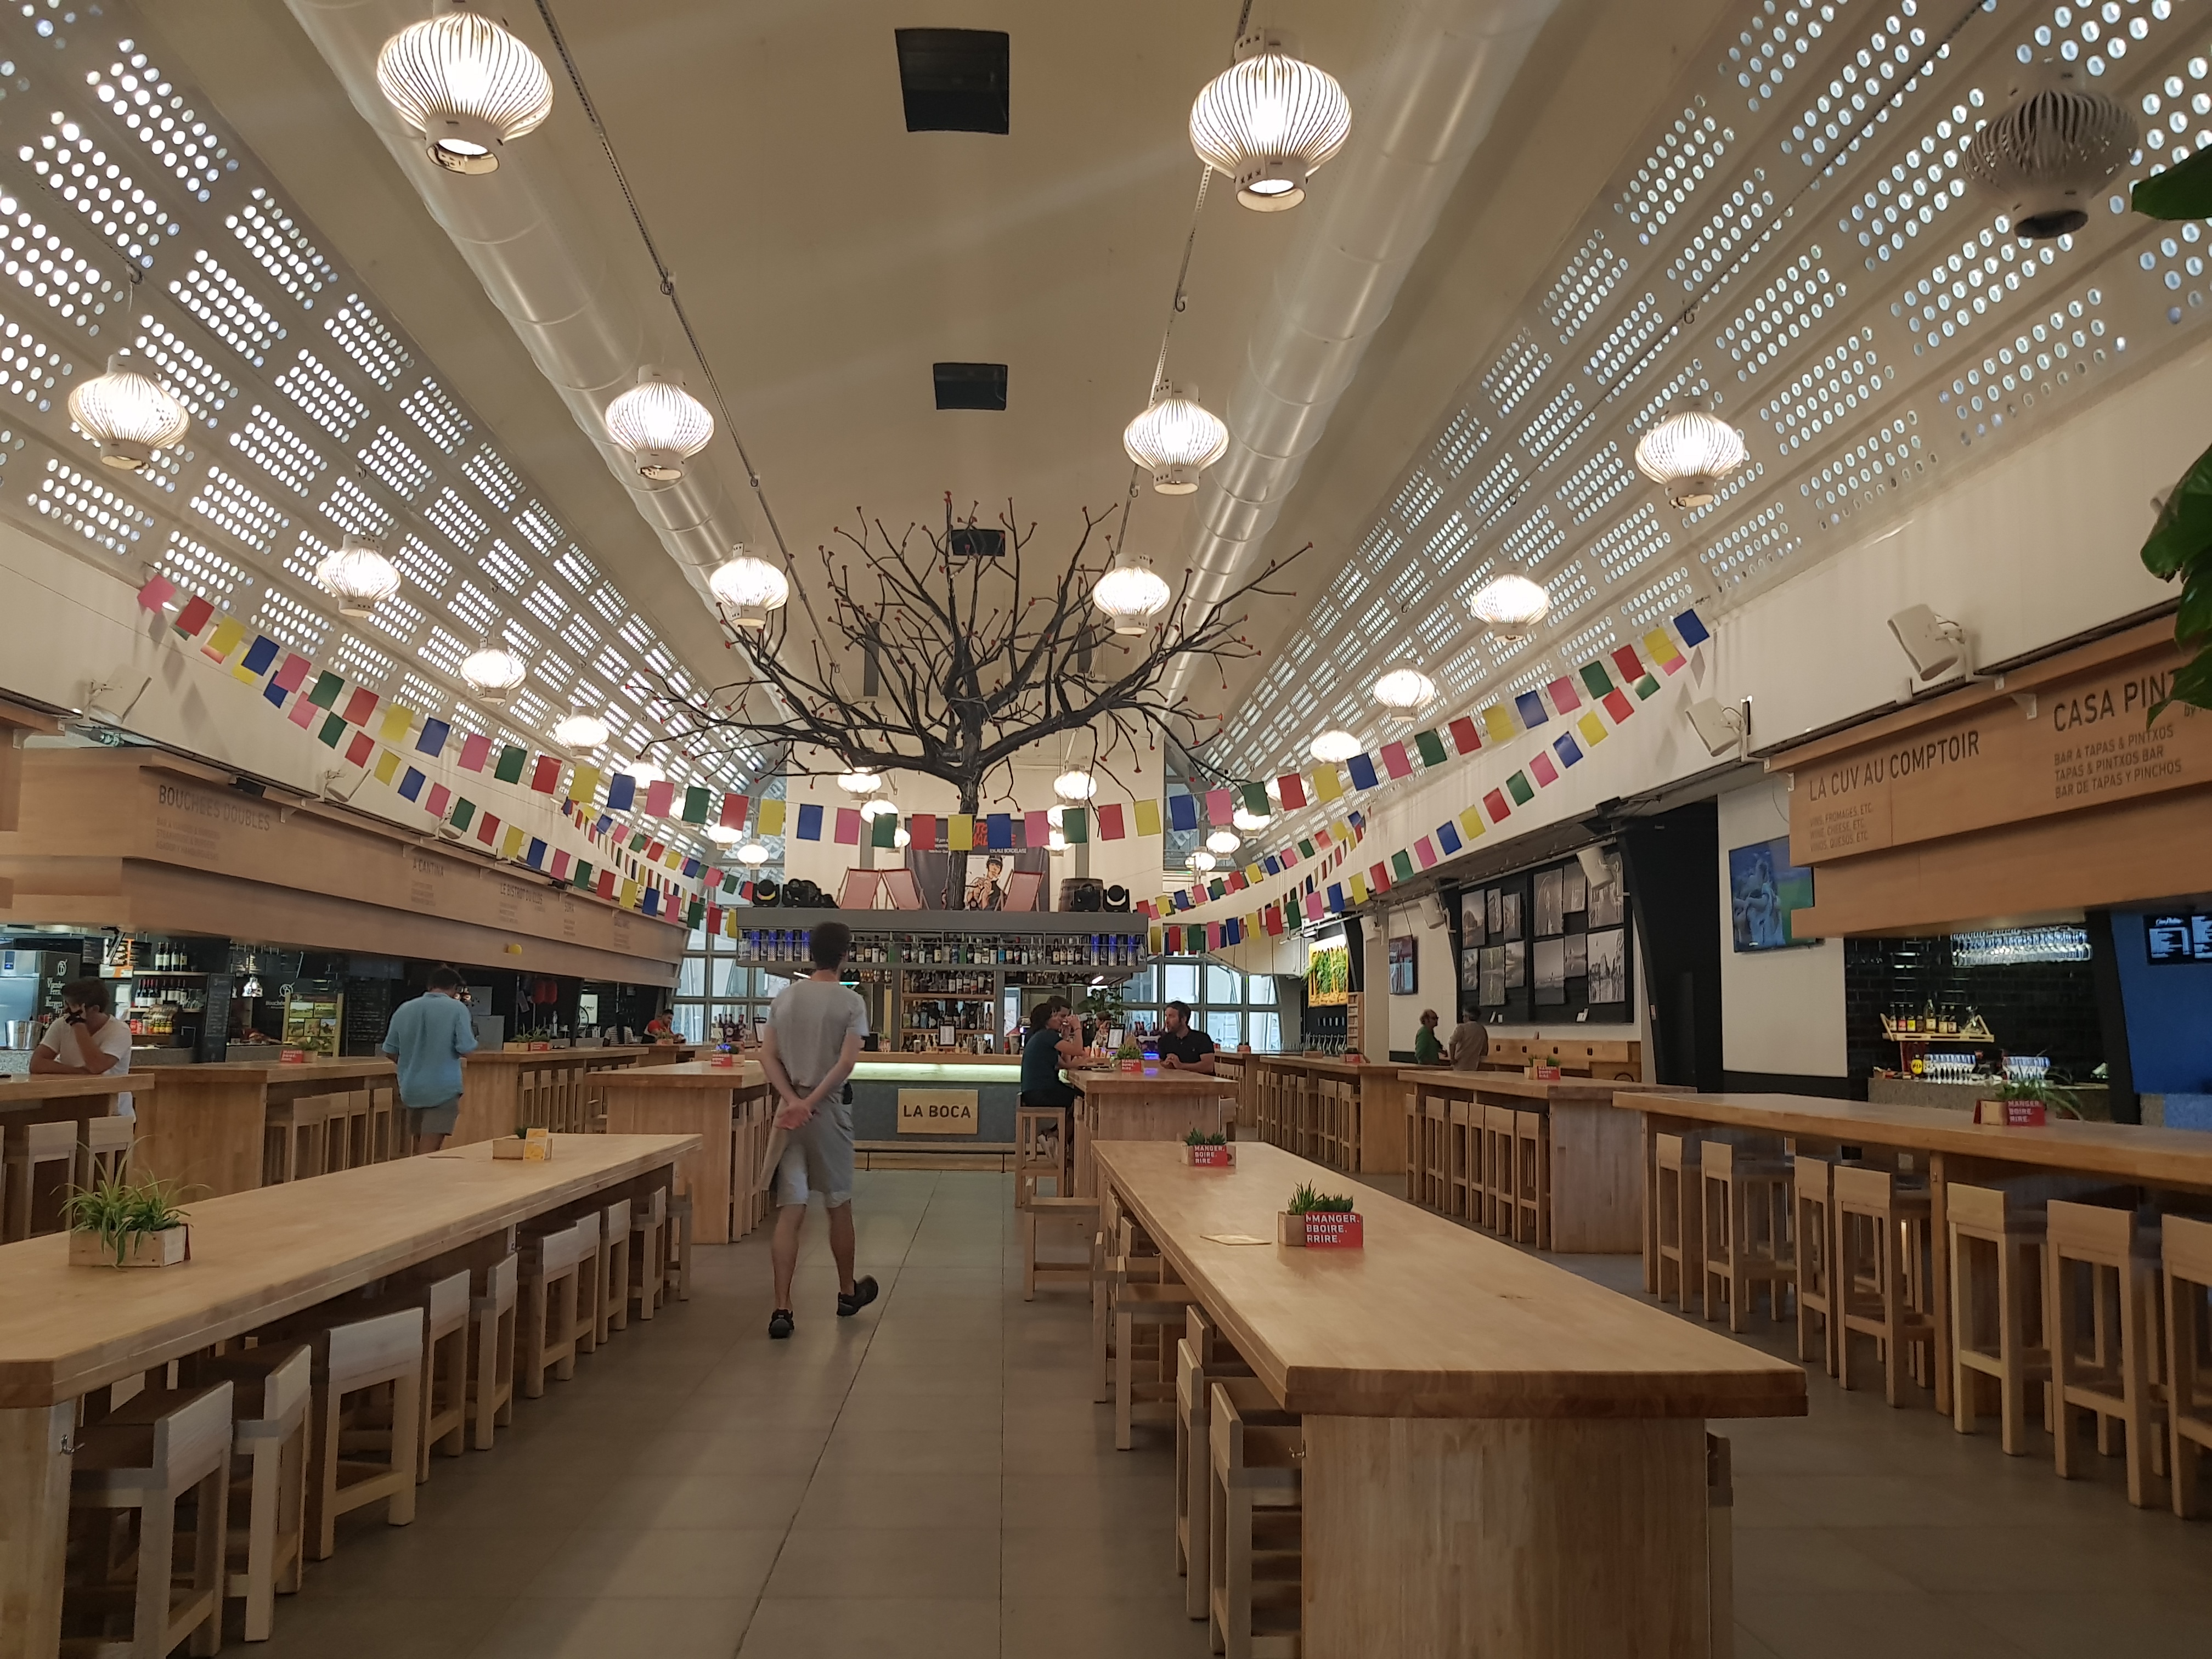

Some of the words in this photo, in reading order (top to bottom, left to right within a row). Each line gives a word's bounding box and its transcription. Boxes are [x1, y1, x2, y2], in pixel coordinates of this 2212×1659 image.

[2054, 689, 2115, 731] CASA
[2054, 749, 2073, 766] BAR
[2085, 739, 2115, 757] TAPAS
[2118, 737, 2124, 750] &
[2128, 724, 2174, 747] PINTXOS
[1810, 777, 1827, 802] LA
[1831, 766, 1859, 795] CUV
[1864, 758, 1884, 786] AU
[1890, 730, 1979, 779] COMPTOIR
[2055, 764, 2084, 782] TAPAS
[2087, 762, 2093, 775] &
[2096, 751, 2139, 771] PINTXOS
[2142, 744, 2164, 763] BAR
[2055, 783, 2073, 799] BAR
[2076, 781, 2089, 795] DE
[2092, 773, 2123, 790] TAPAS
[2125, 771, 2131, 782] Y
[2134, 758, 2182, 782] PINCHOS
[223, 802, 270, 831] DOUBLES
[904, 1104, 923, 1118] LA
[929, 1105, 970, 1118] BOCA
[1312, 1214, 1360, 1223] MANGER.
[1312, 1224, 1347, 1233] BOIRE.
[1313, 1234, 1341, 1243] RIRE.
